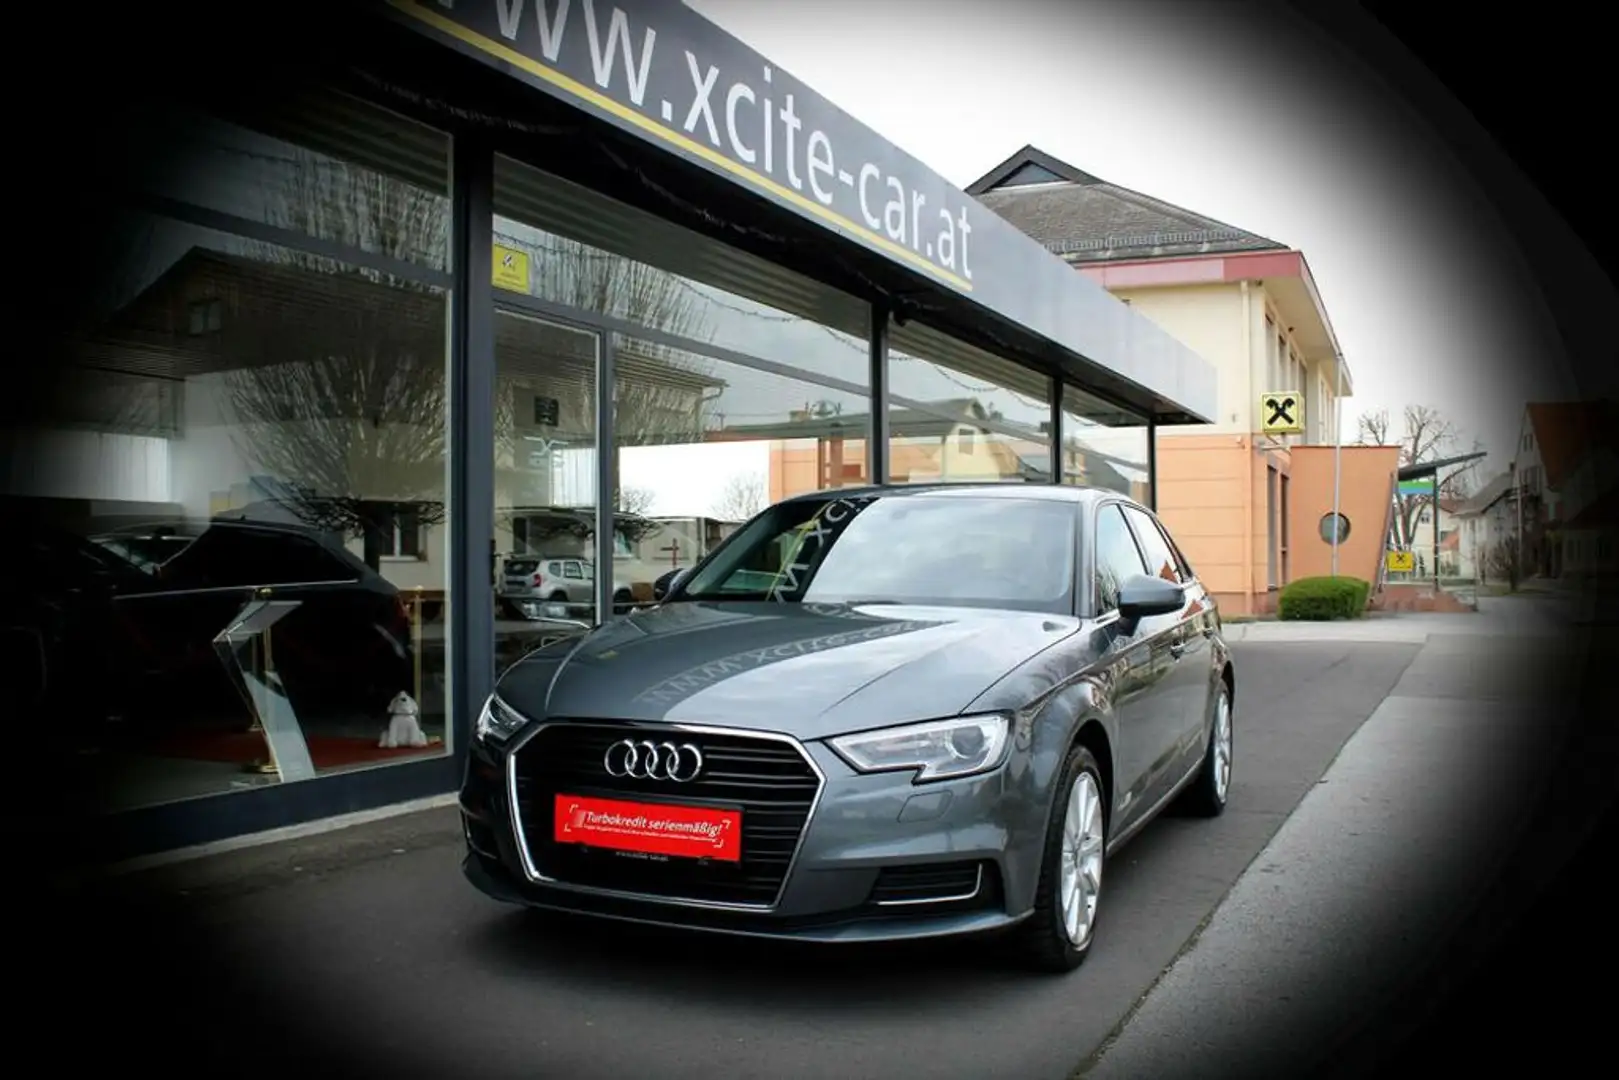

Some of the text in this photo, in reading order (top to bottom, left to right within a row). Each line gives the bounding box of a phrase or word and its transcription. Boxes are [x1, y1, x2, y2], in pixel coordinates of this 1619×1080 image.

[437, 0, 974, 279] ww.xcite-car.at
[587, 810, 647, 829] Turbokredit
[648, 819, 723, 837] serienmäßig!
